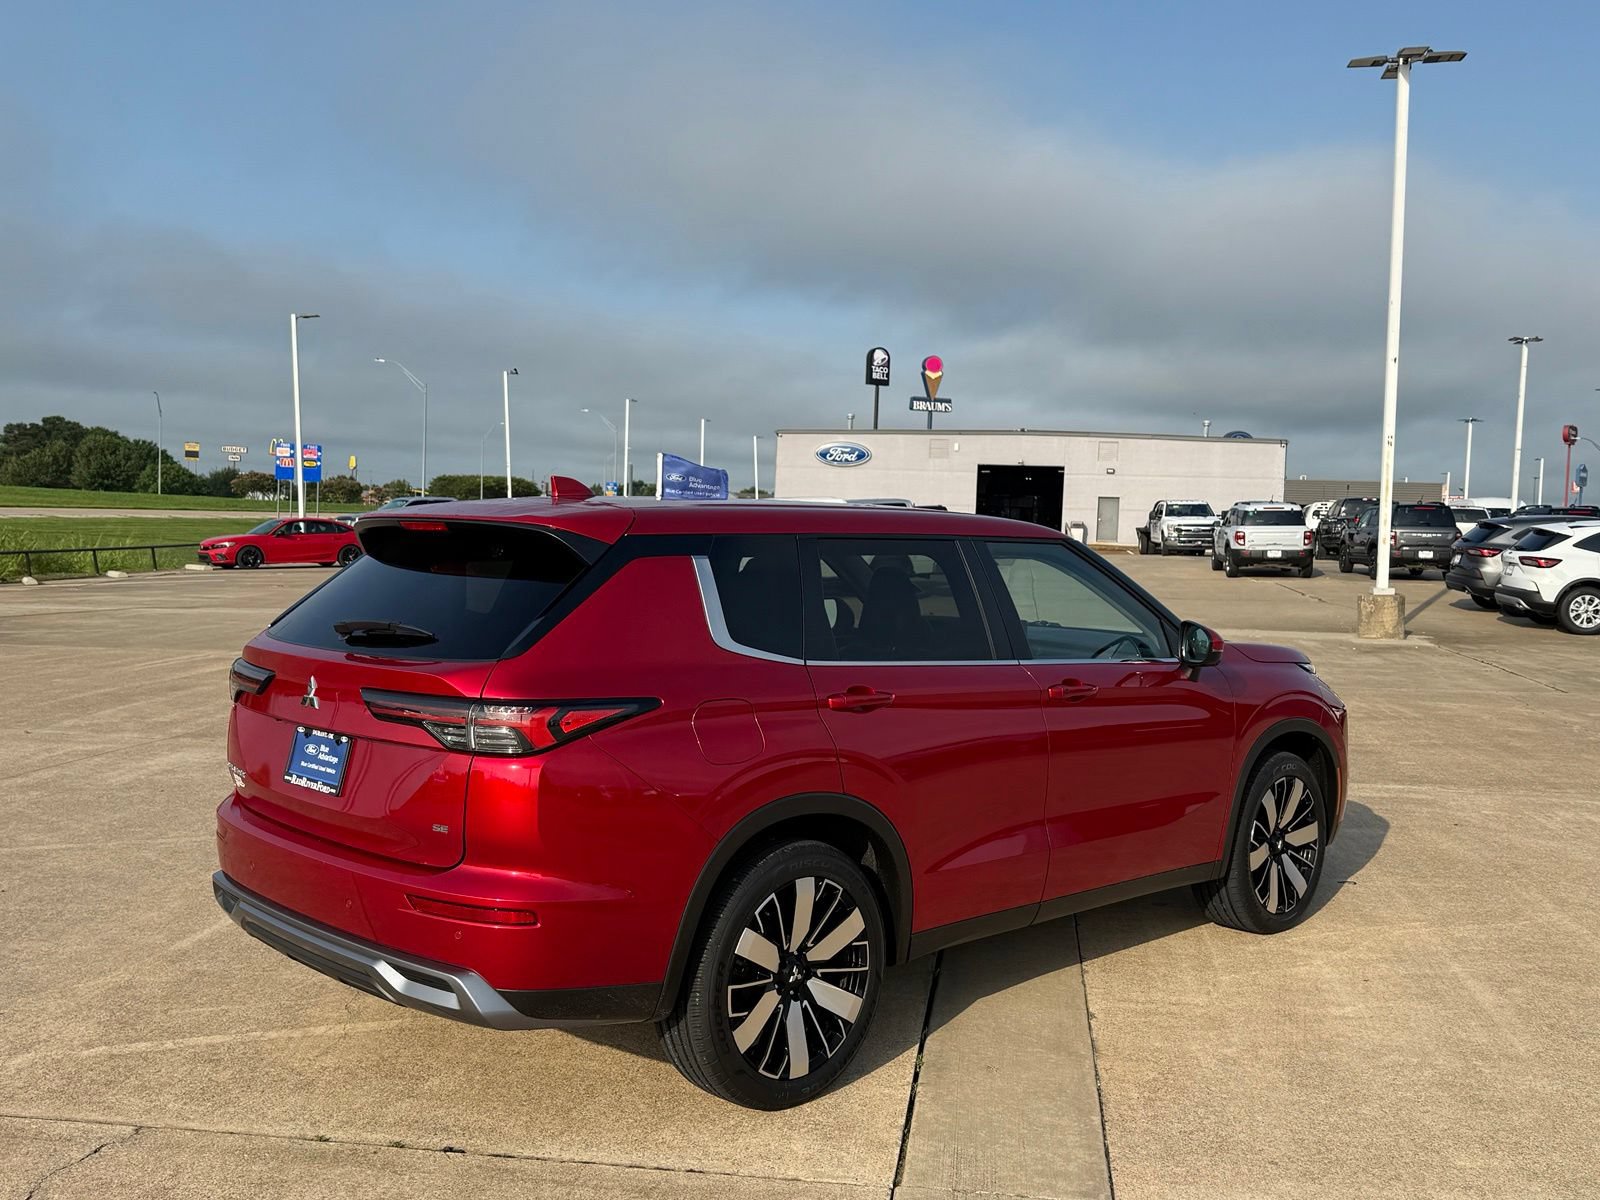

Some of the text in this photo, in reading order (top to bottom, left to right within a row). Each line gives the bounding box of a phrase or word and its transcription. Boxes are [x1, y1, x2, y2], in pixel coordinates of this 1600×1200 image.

[871, 366, 888, 374] TACO
[913, 400, 952, 412] BRAUM'S
[826, 447, 859, 462] Ford
[688, 482, 721, 490] Advantage
[432, 823, 449, 833] SE
